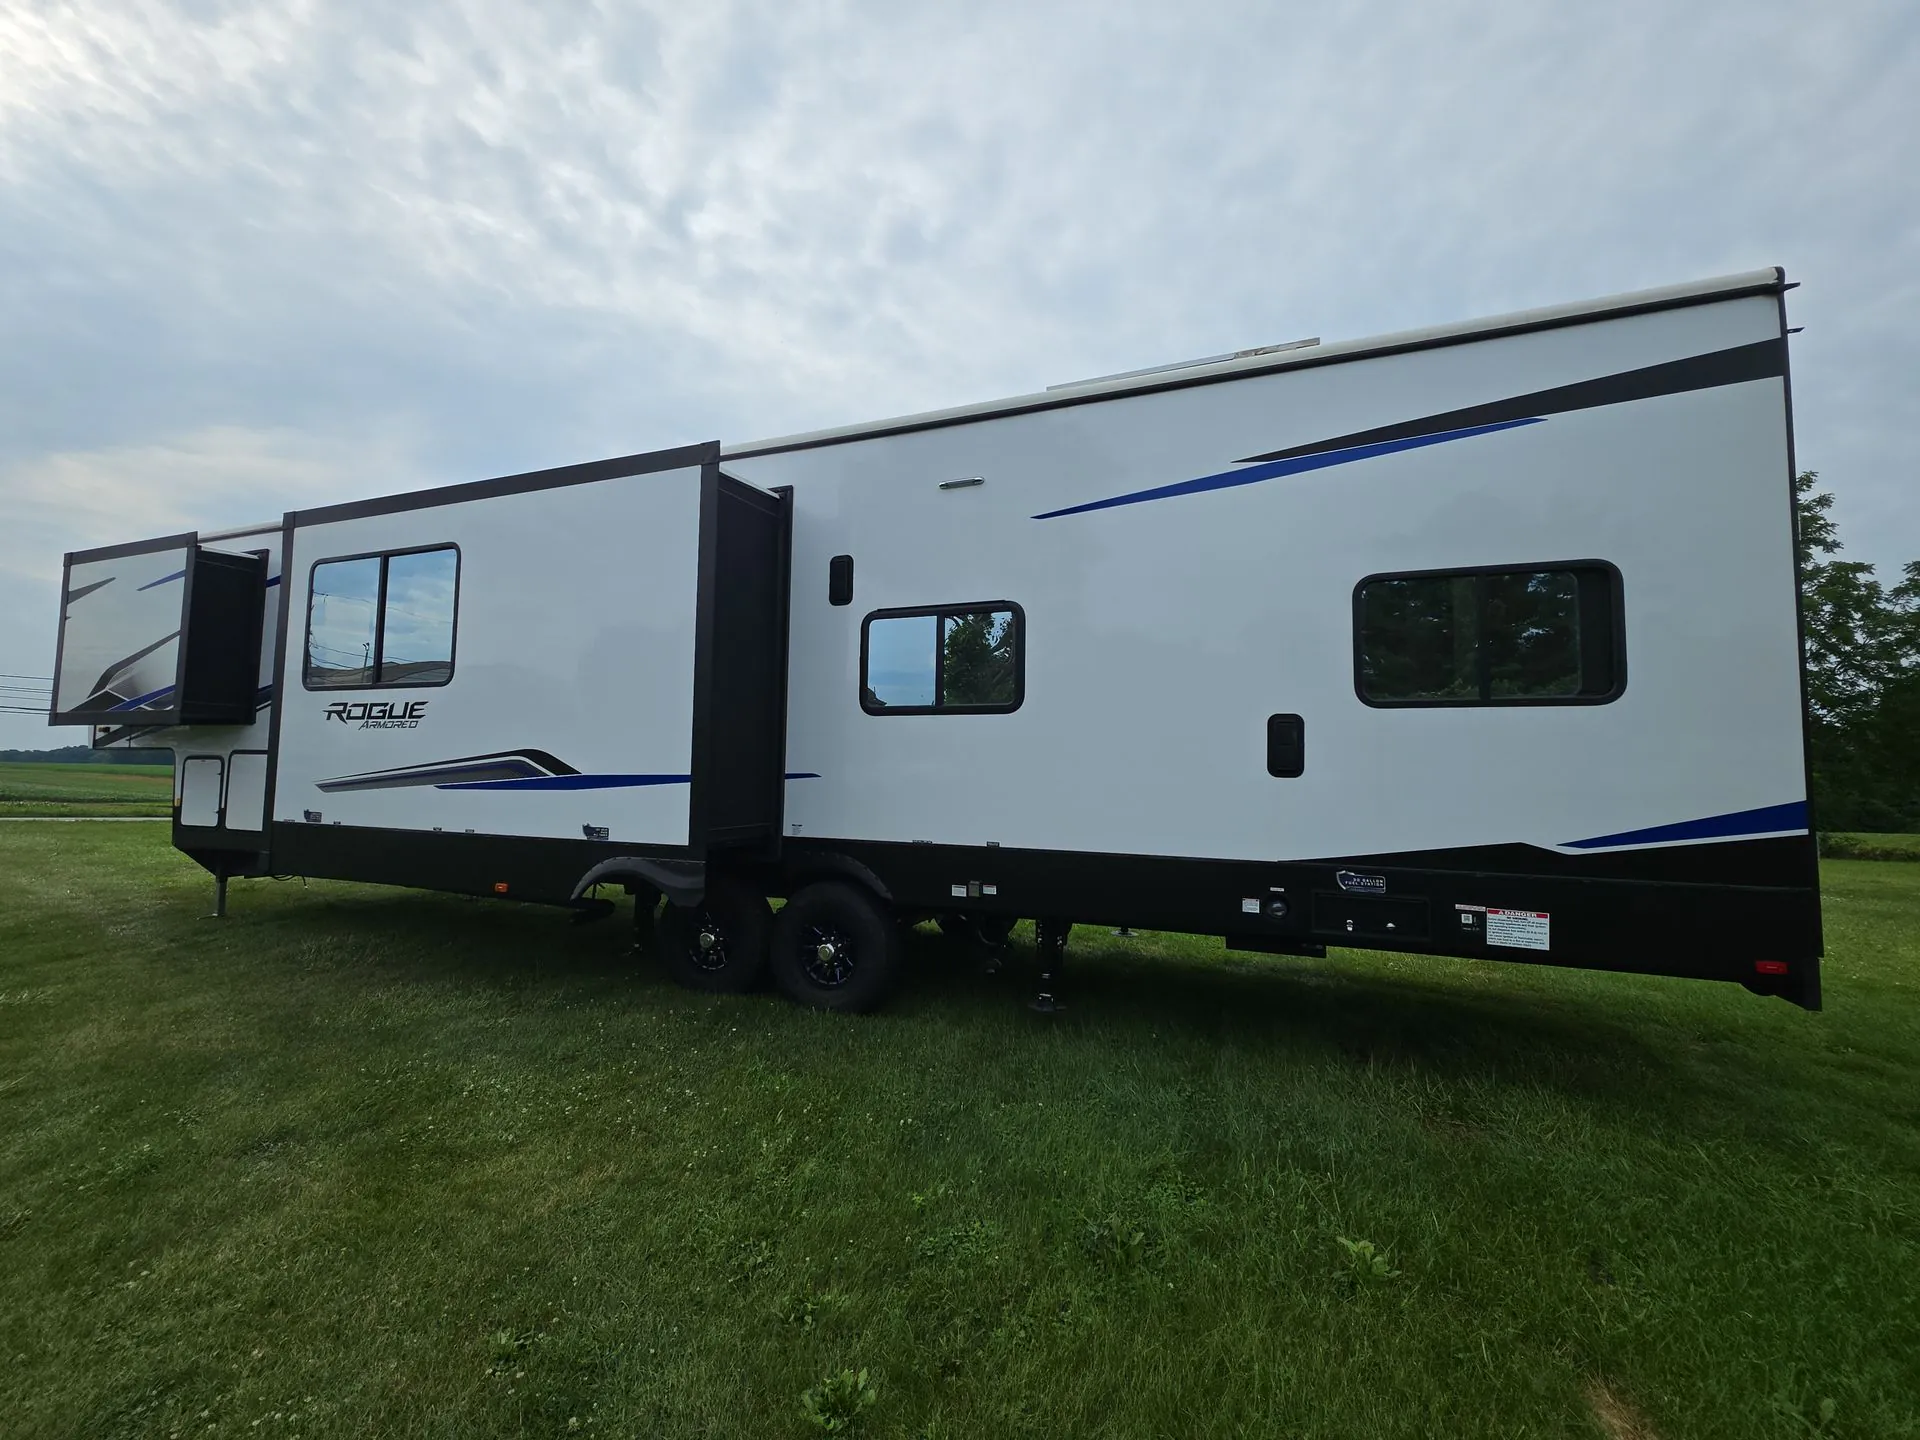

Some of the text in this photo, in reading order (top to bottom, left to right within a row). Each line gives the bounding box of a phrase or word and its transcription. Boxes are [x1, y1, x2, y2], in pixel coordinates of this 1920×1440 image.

[322, 701, 429, 725] ROGUE
[358, 720, 419, 731] ARMORED
[1505, 910, 1537, 918] DANGER
